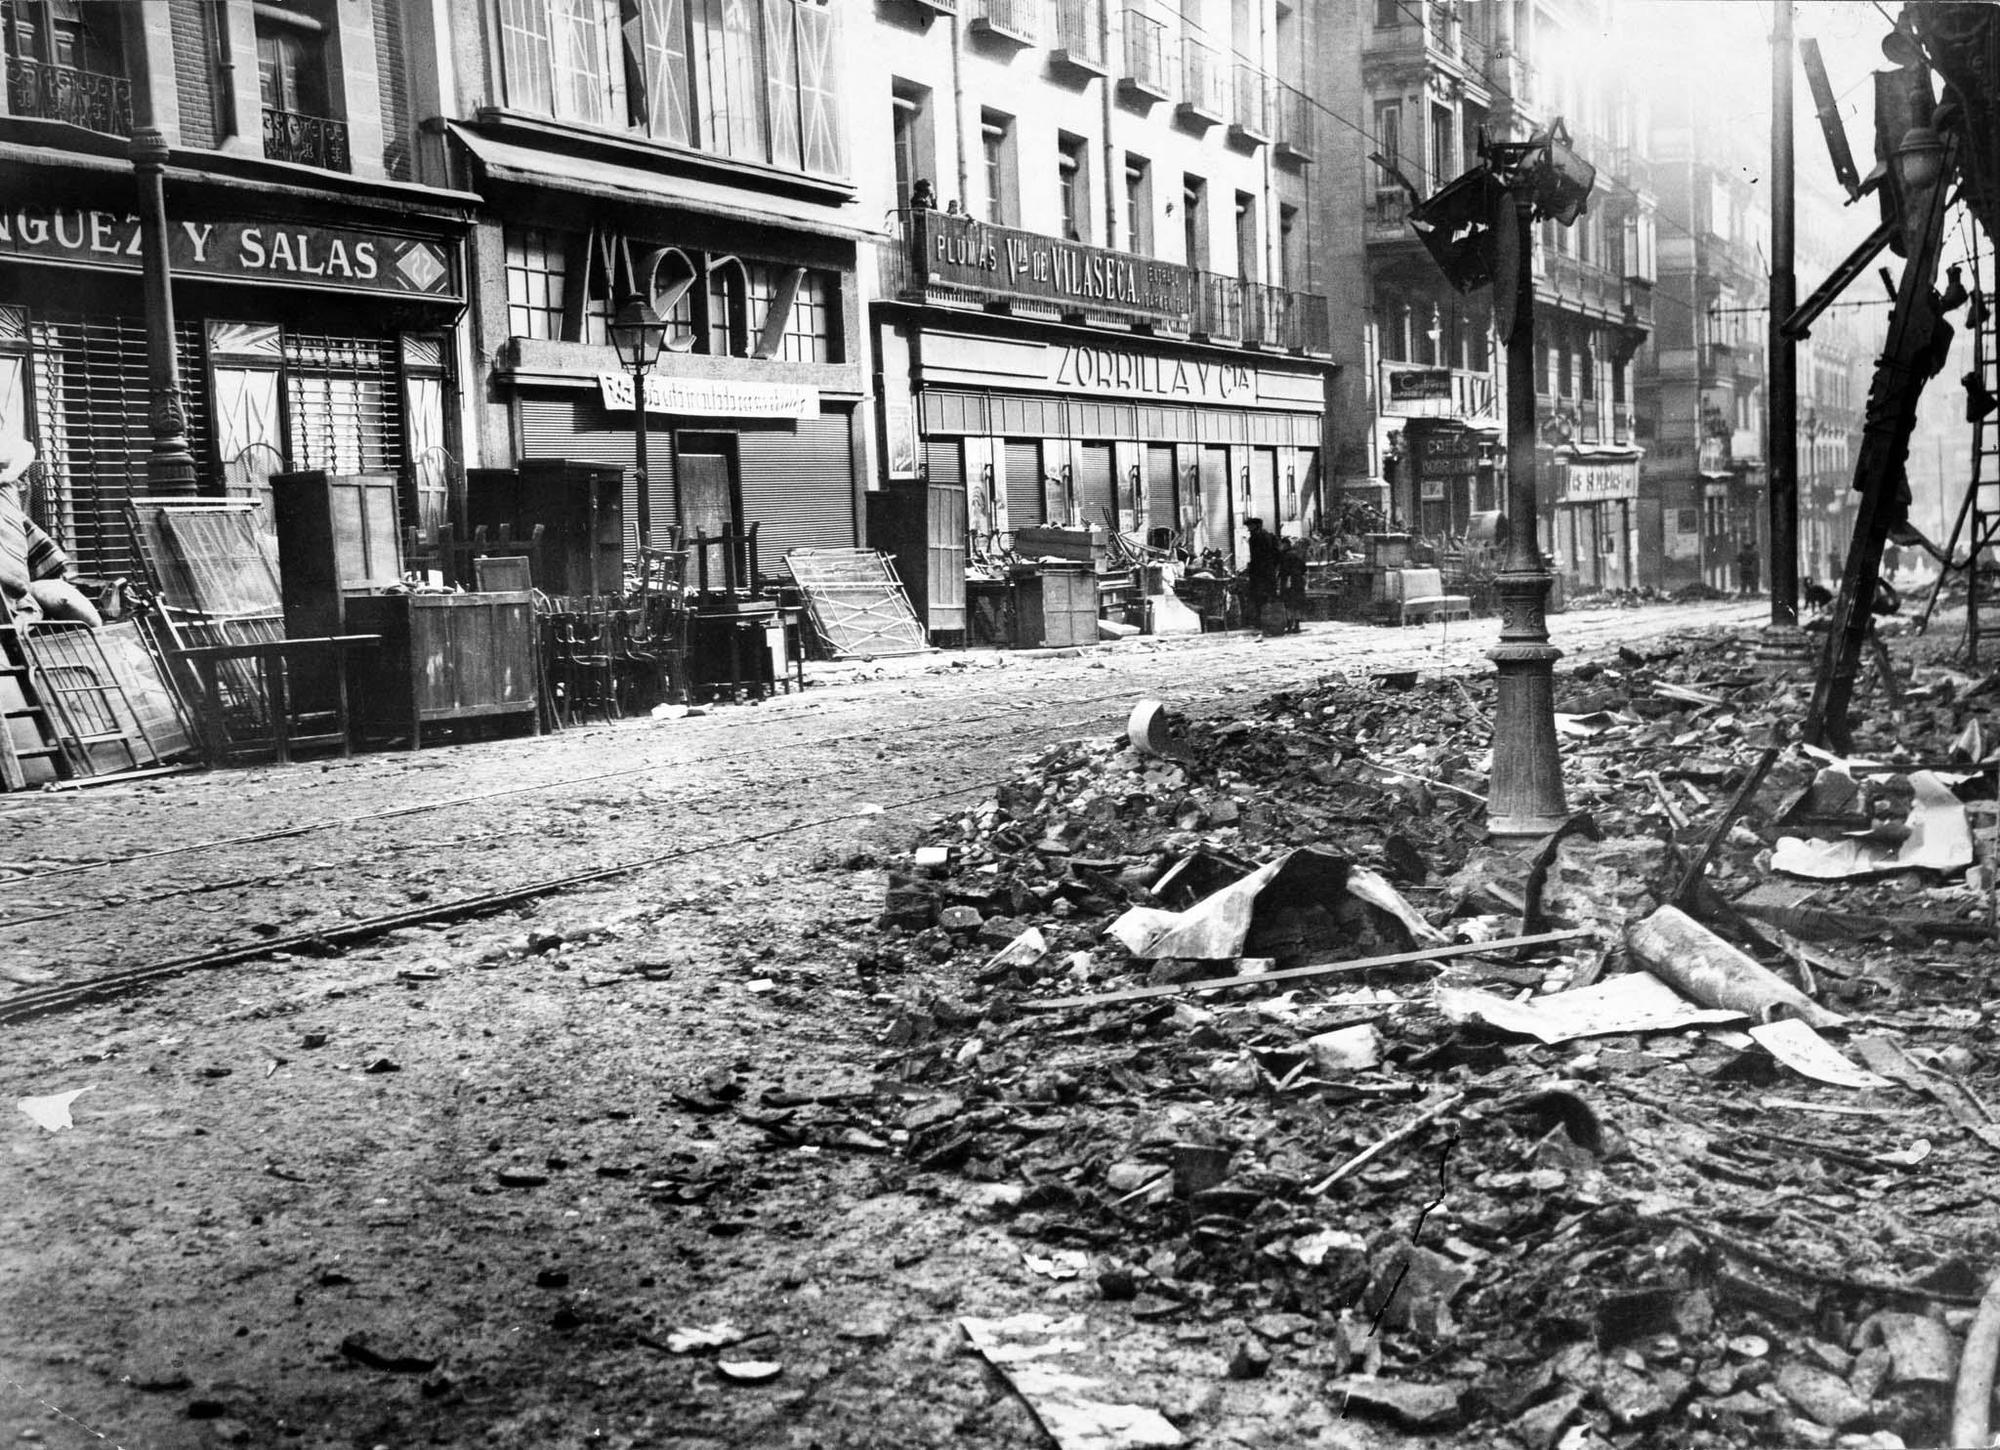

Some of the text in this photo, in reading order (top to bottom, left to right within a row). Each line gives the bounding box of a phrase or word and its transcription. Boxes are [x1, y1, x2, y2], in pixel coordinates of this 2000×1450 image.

[182, 221, 212, 262] Y
[239, 227, 377, 279] SALAS
[937, 234, 997, 271] PLUMAS
[1033, 251, 1048, 281] DE
[1056, 345, 1190, 395] ZORRILLA
[1196, 360, 1210, 396] Y
